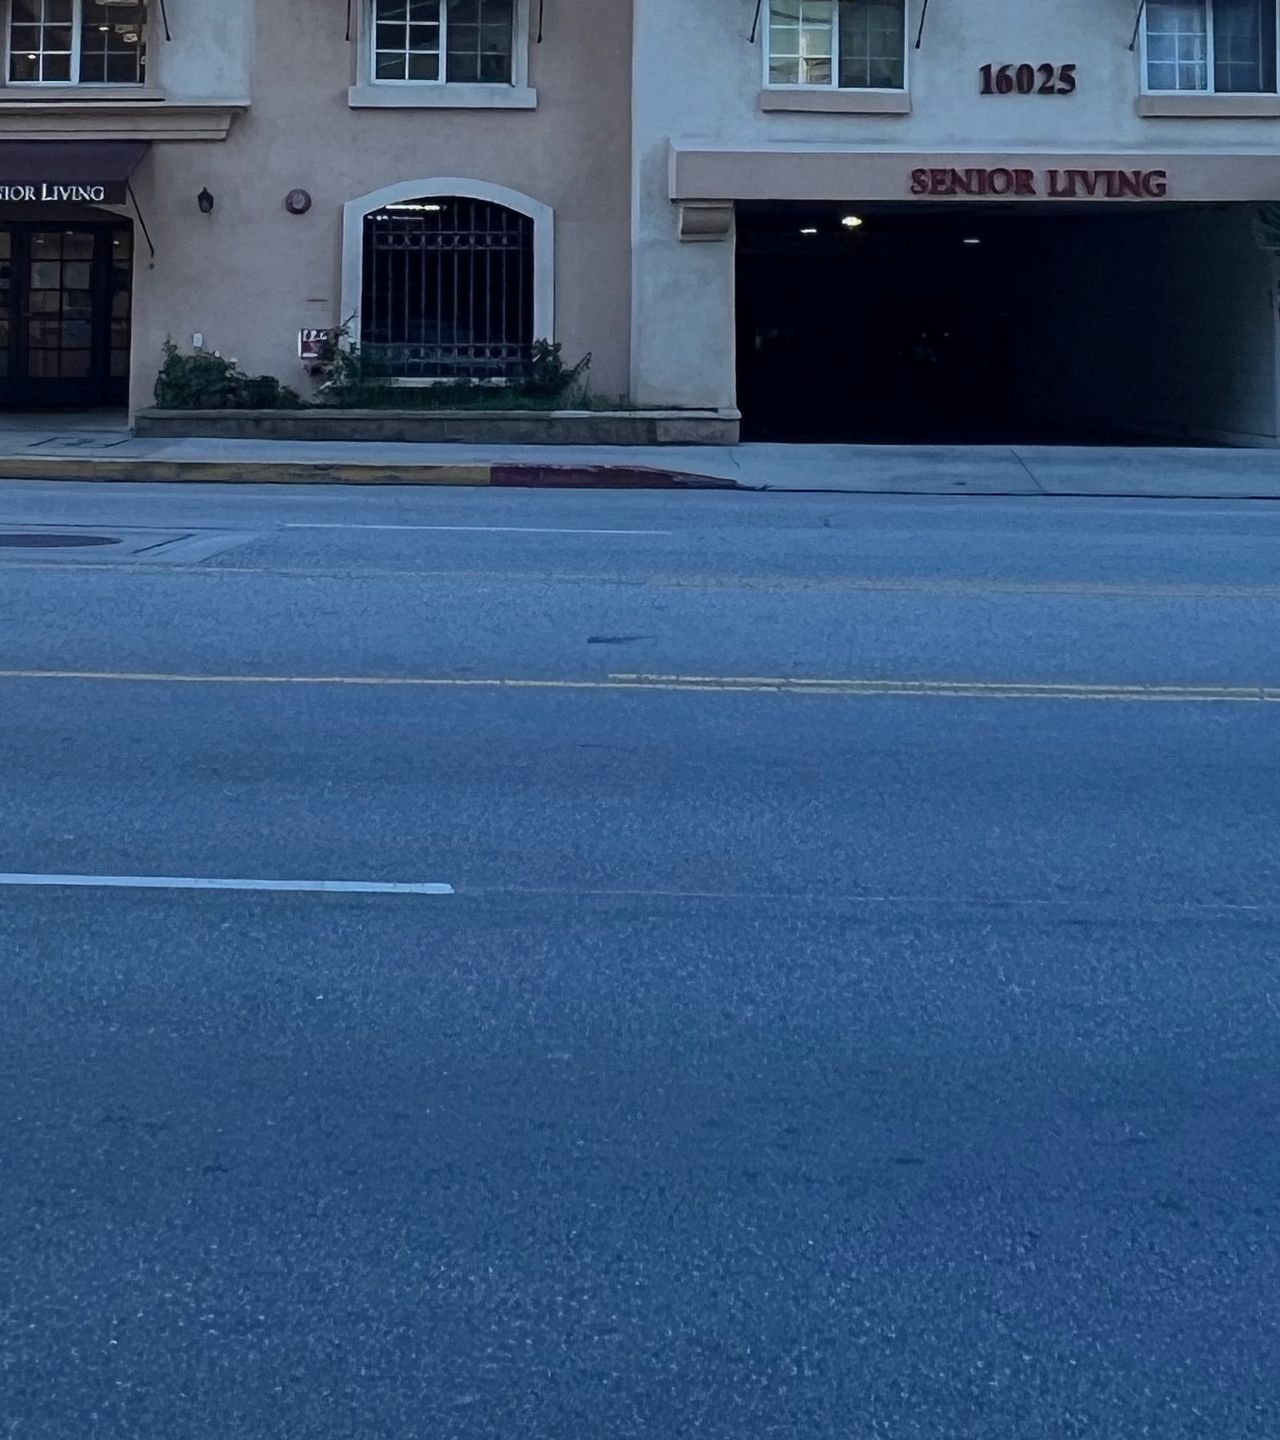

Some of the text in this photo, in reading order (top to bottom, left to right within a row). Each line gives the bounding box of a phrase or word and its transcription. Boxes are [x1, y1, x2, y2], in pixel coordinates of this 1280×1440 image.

[979, 63, 1077, 96] 16025
[910, 167, 1168, 199] SENIOR LIVING
